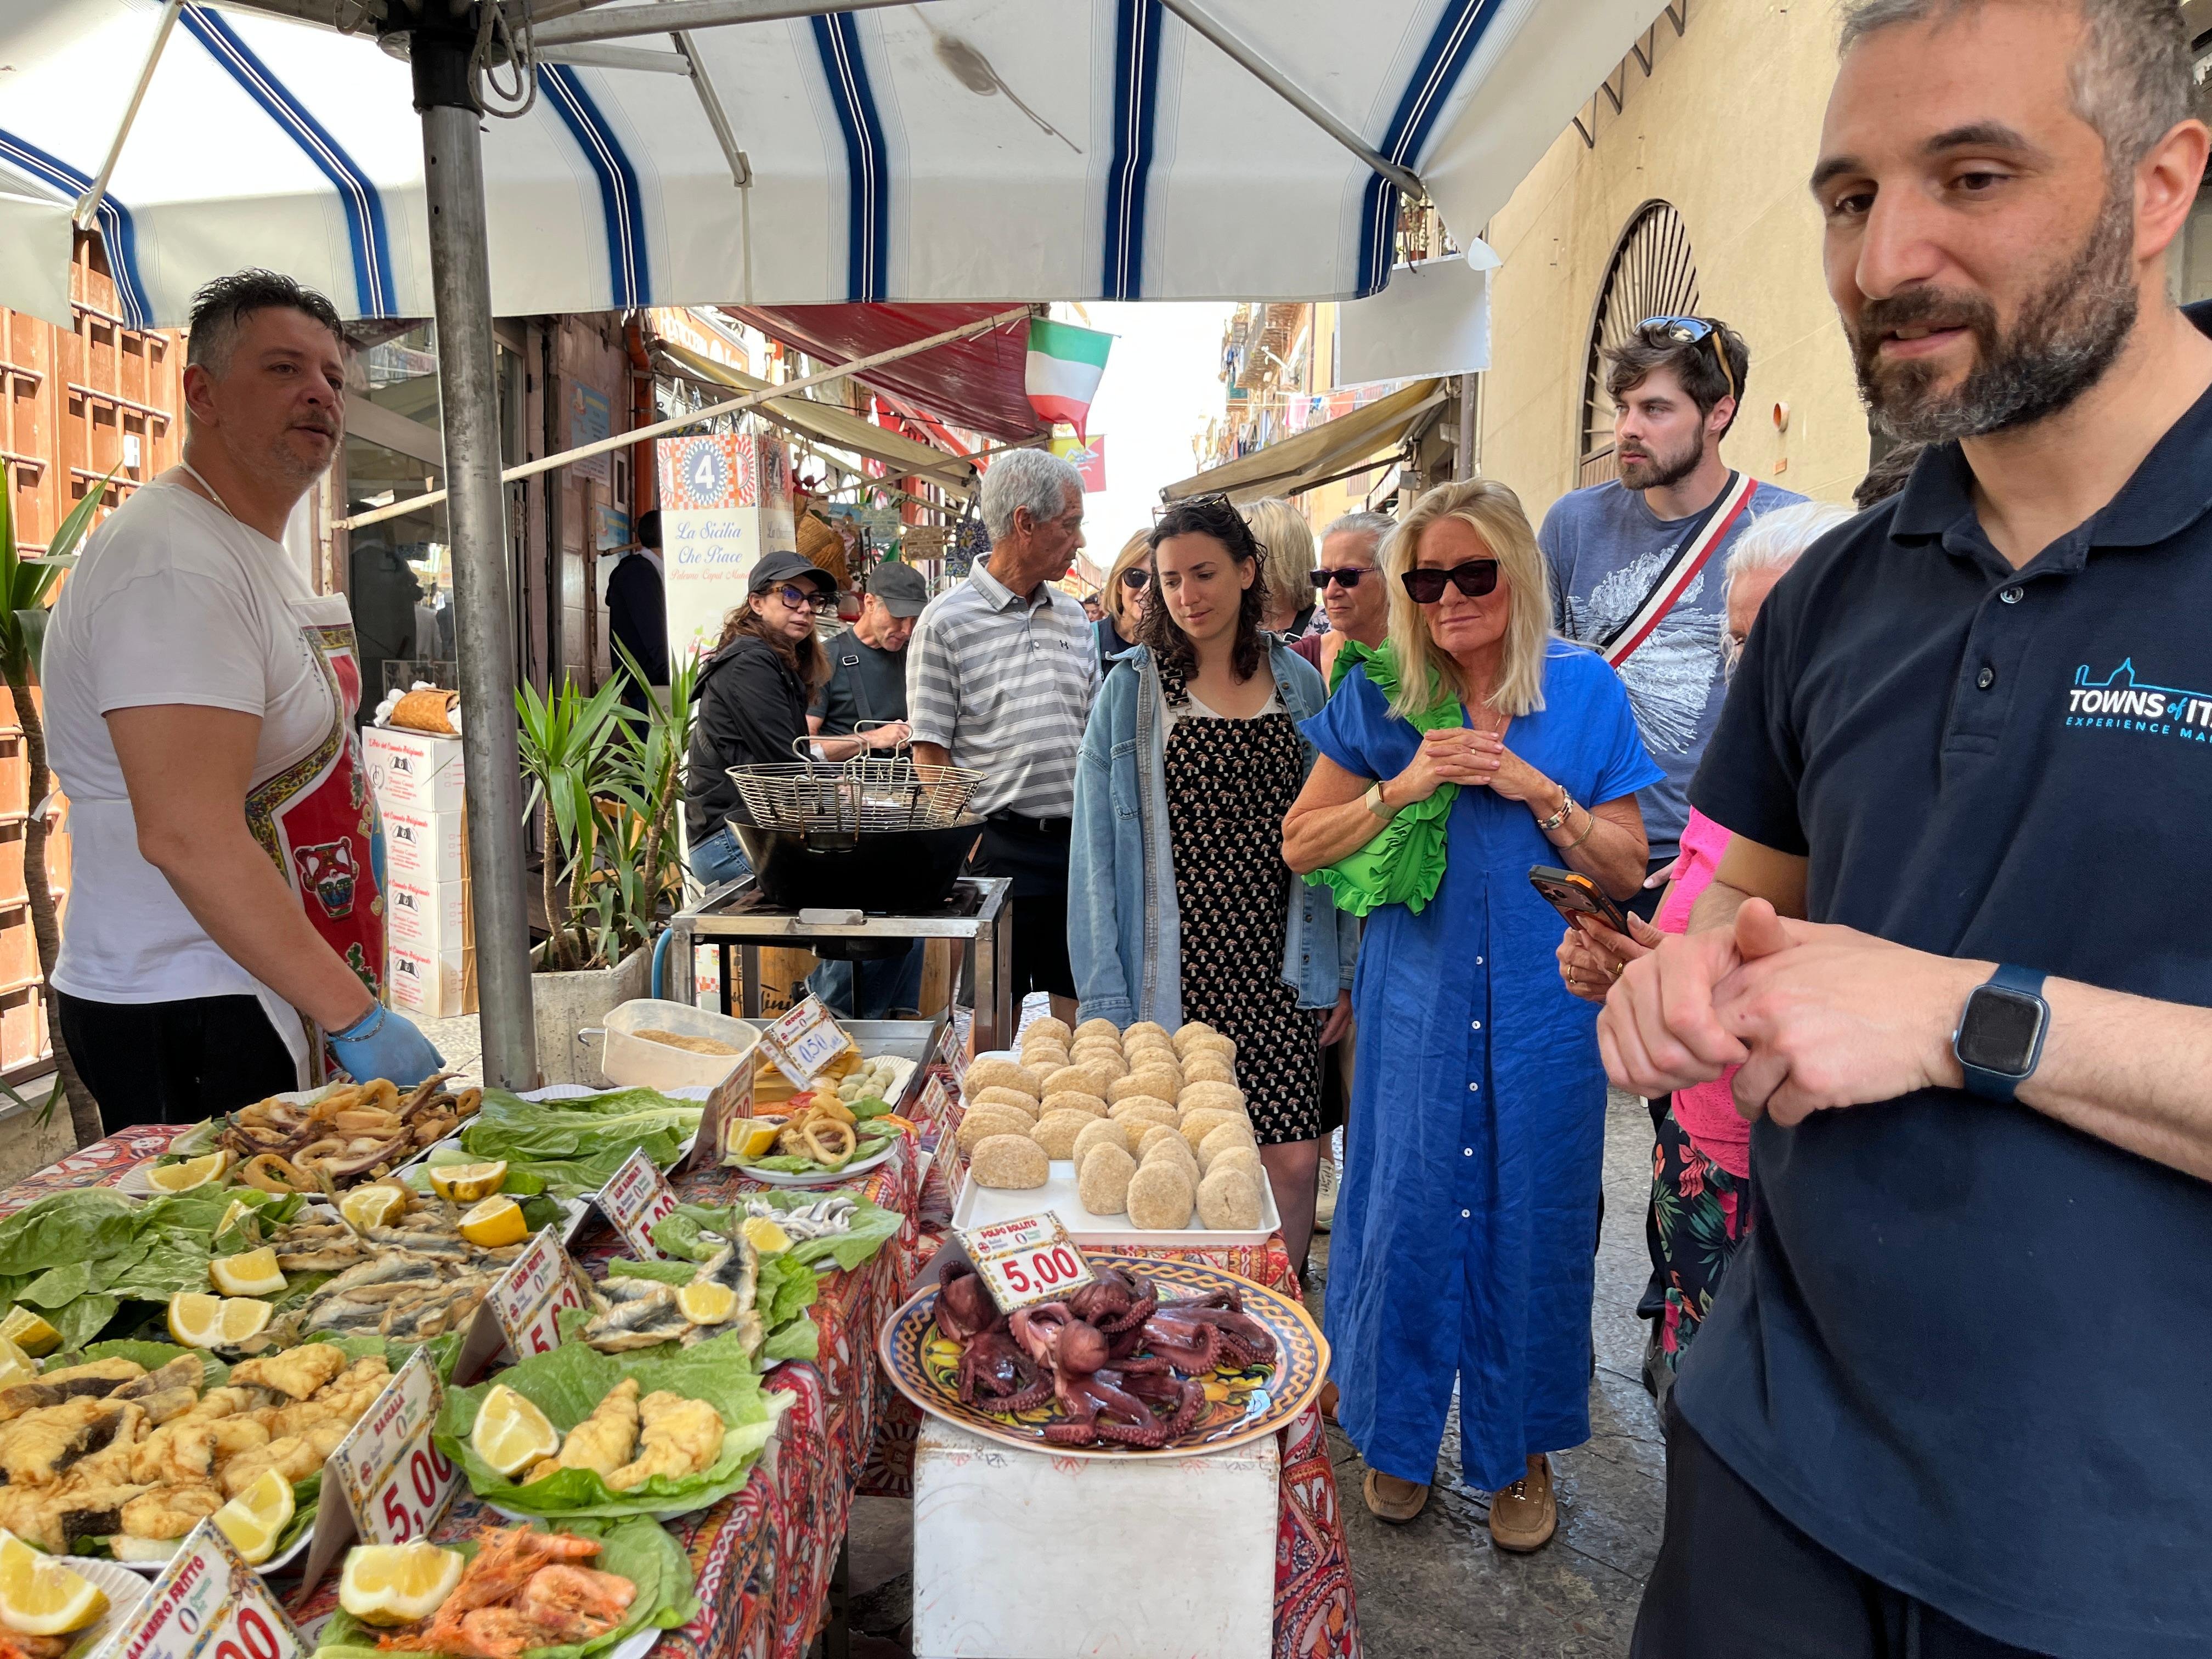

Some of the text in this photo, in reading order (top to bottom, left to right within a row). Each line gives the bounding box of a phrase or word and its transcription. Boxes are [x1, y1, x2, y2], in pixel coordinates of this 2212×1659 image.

[695, 455, 715, 489] 4
[675, 520, 742, 540] La Sicilia
[678, 544, 743, 564] Che Piace
[670, 568, 699, 581] Palermo
[702, 568, 722, 582] Caput
[2070, 690, 2212, 728] TOWNS of IT
[2066, 716, 2170, 734] EXPERIENCE
[980, 1219, 1037, 1239] POLPO BOLLITO
[1002, 1248, 1079, 1294] 5,00
[167, 1555, 205, 1605] FRITTO
